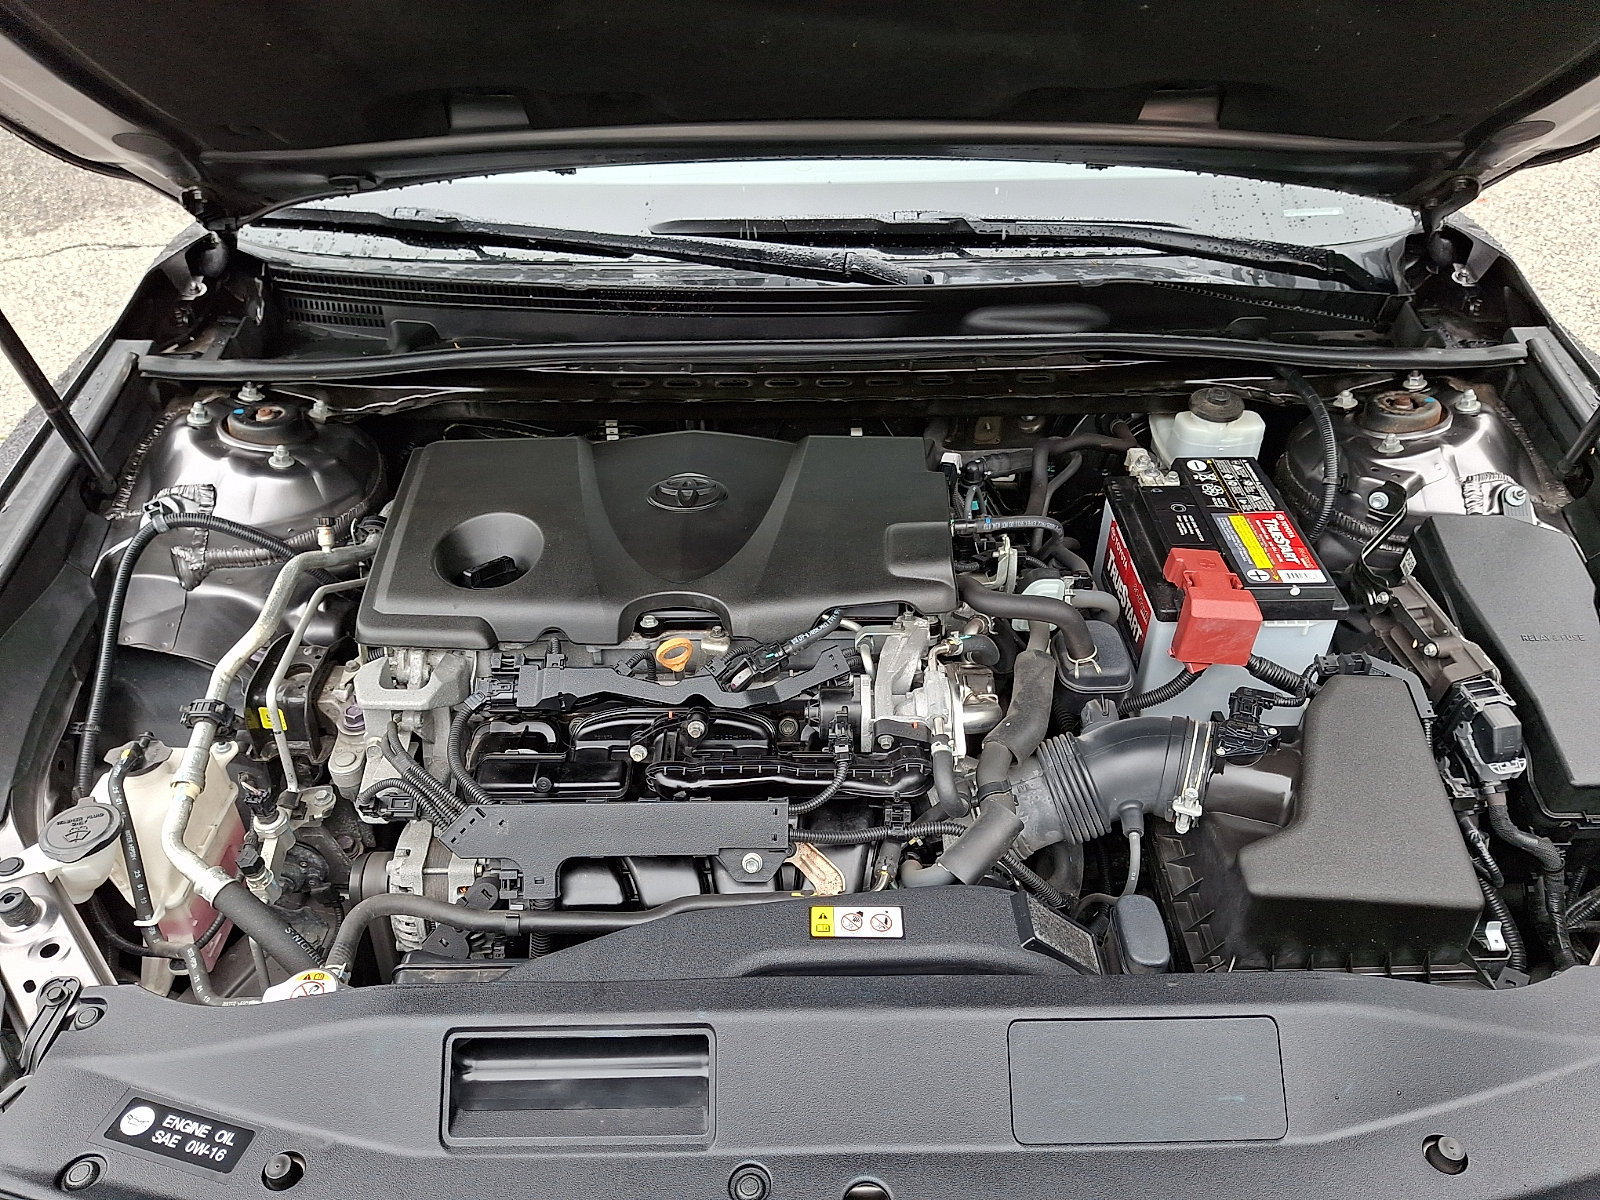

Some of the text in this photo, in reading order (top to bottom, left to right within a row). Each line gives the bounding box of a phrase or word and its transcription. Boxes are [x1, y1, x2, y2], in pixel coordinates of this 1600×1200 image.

[1281, 520, 1296, 539] TOYOTA
[1113, 538, 1128, 570] TOYOTA
[1520, 633, 1551, 642] RELAY
[1560, 633, 1585, 642] FUSE
[151, 1130, 228, 1162] SAE 0W-16
[162, 1114, 237, 1147] ENGINE OIL
